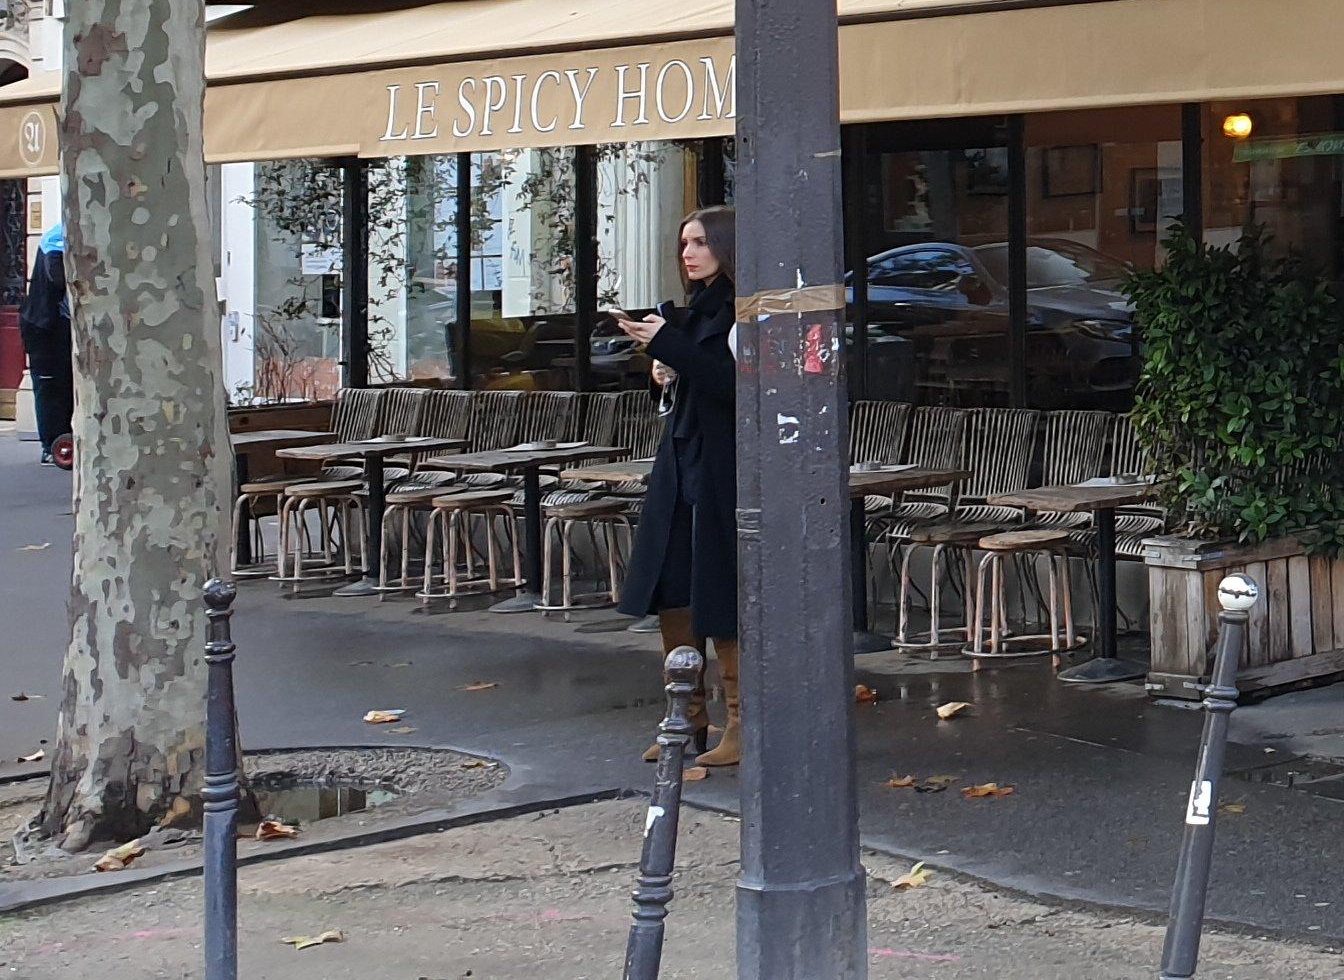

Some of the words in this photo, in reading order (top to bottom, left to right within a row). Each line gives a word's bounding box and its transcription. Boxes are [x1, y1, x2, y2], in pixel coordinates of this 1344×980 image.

[379, 80, 440, 142] LE
[452, 66, 599, 138] SPICY
[610, 53, 737, 129] HOM
